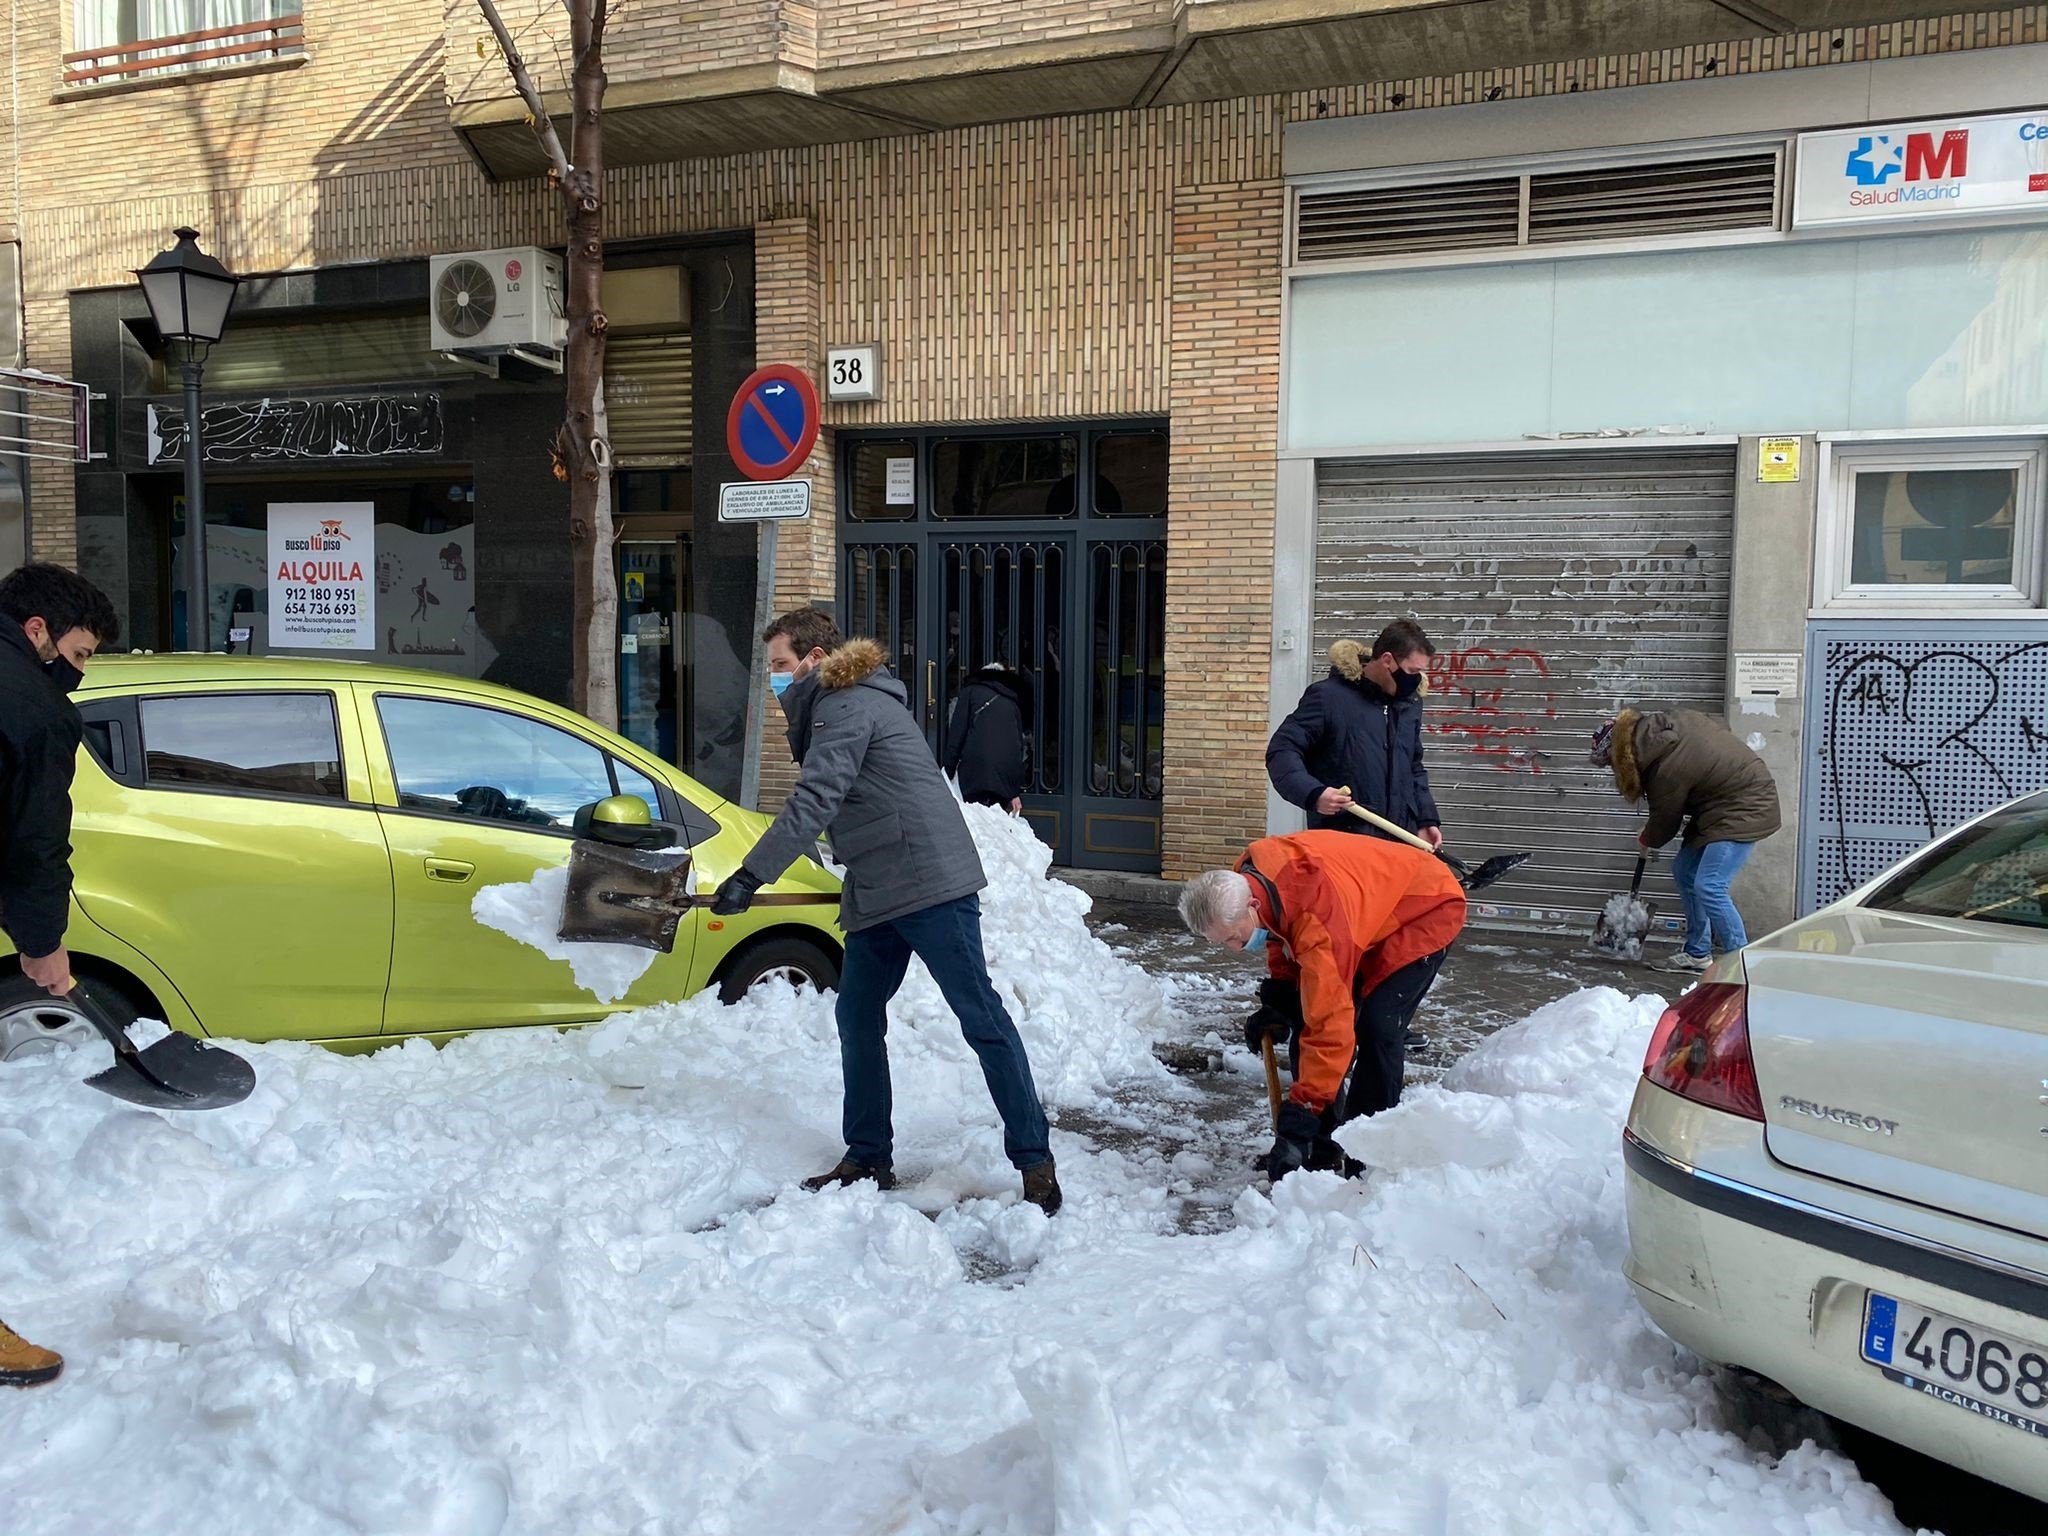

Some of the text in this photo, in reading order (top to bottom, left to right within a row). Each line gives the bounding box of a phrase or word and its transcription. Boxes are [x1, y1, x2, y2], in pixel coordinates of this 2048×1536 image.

[507, 282, 520, 293] LG
[832, 358, 863, 385] 38
[277, 561, 364, 585] ALQUILA
[285, 588, 356, 601] 912 180 951
[285, 603, 356, 615] 654 736 693
[285, 616, 356, 625] www.buscotupiso.com
[1780, 1095, 1899, 1136] PEUGEOT
[1873, 1316, 2048, 1410] E 4068
[1923, 1383, 1981, 1413] ALCALA
